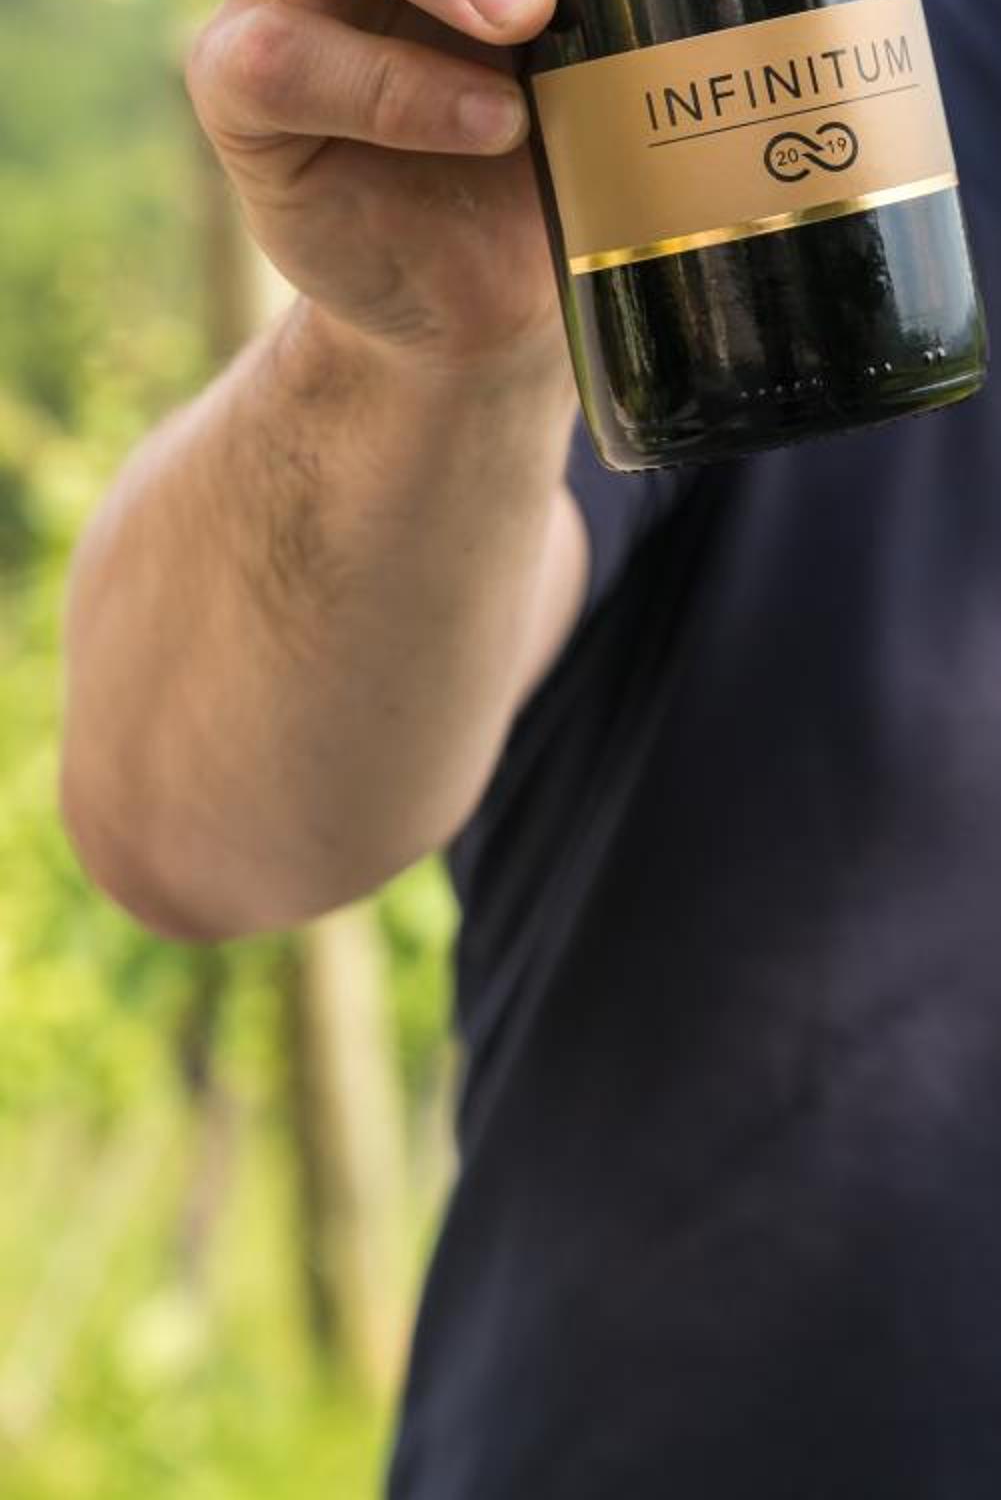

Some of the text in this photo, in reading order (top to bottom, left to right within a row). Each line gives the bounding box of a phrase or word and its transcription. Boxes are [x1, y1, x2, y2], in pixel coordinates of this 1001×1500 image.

[644, 35, 913, 131] INFINITUM
[775, 136, 847, 168] 20 19
